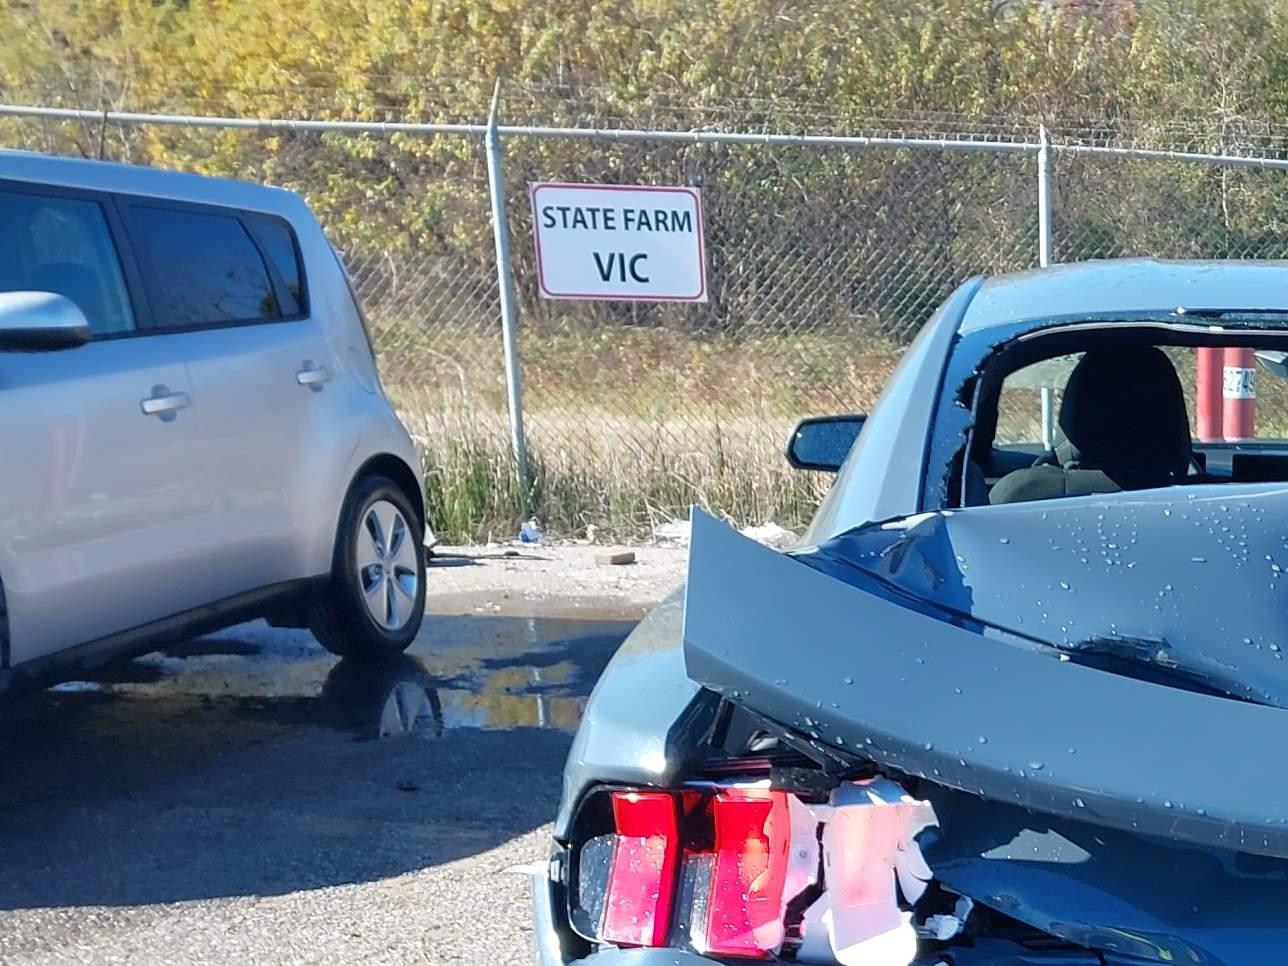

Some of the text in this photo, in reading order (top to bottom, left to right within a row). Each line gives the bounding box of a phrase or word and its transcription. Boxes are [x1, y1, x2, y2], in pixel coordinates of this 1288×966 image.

[542, 206, 693, 233] STATE FARM
[592, 252, 650, 283] VIC
